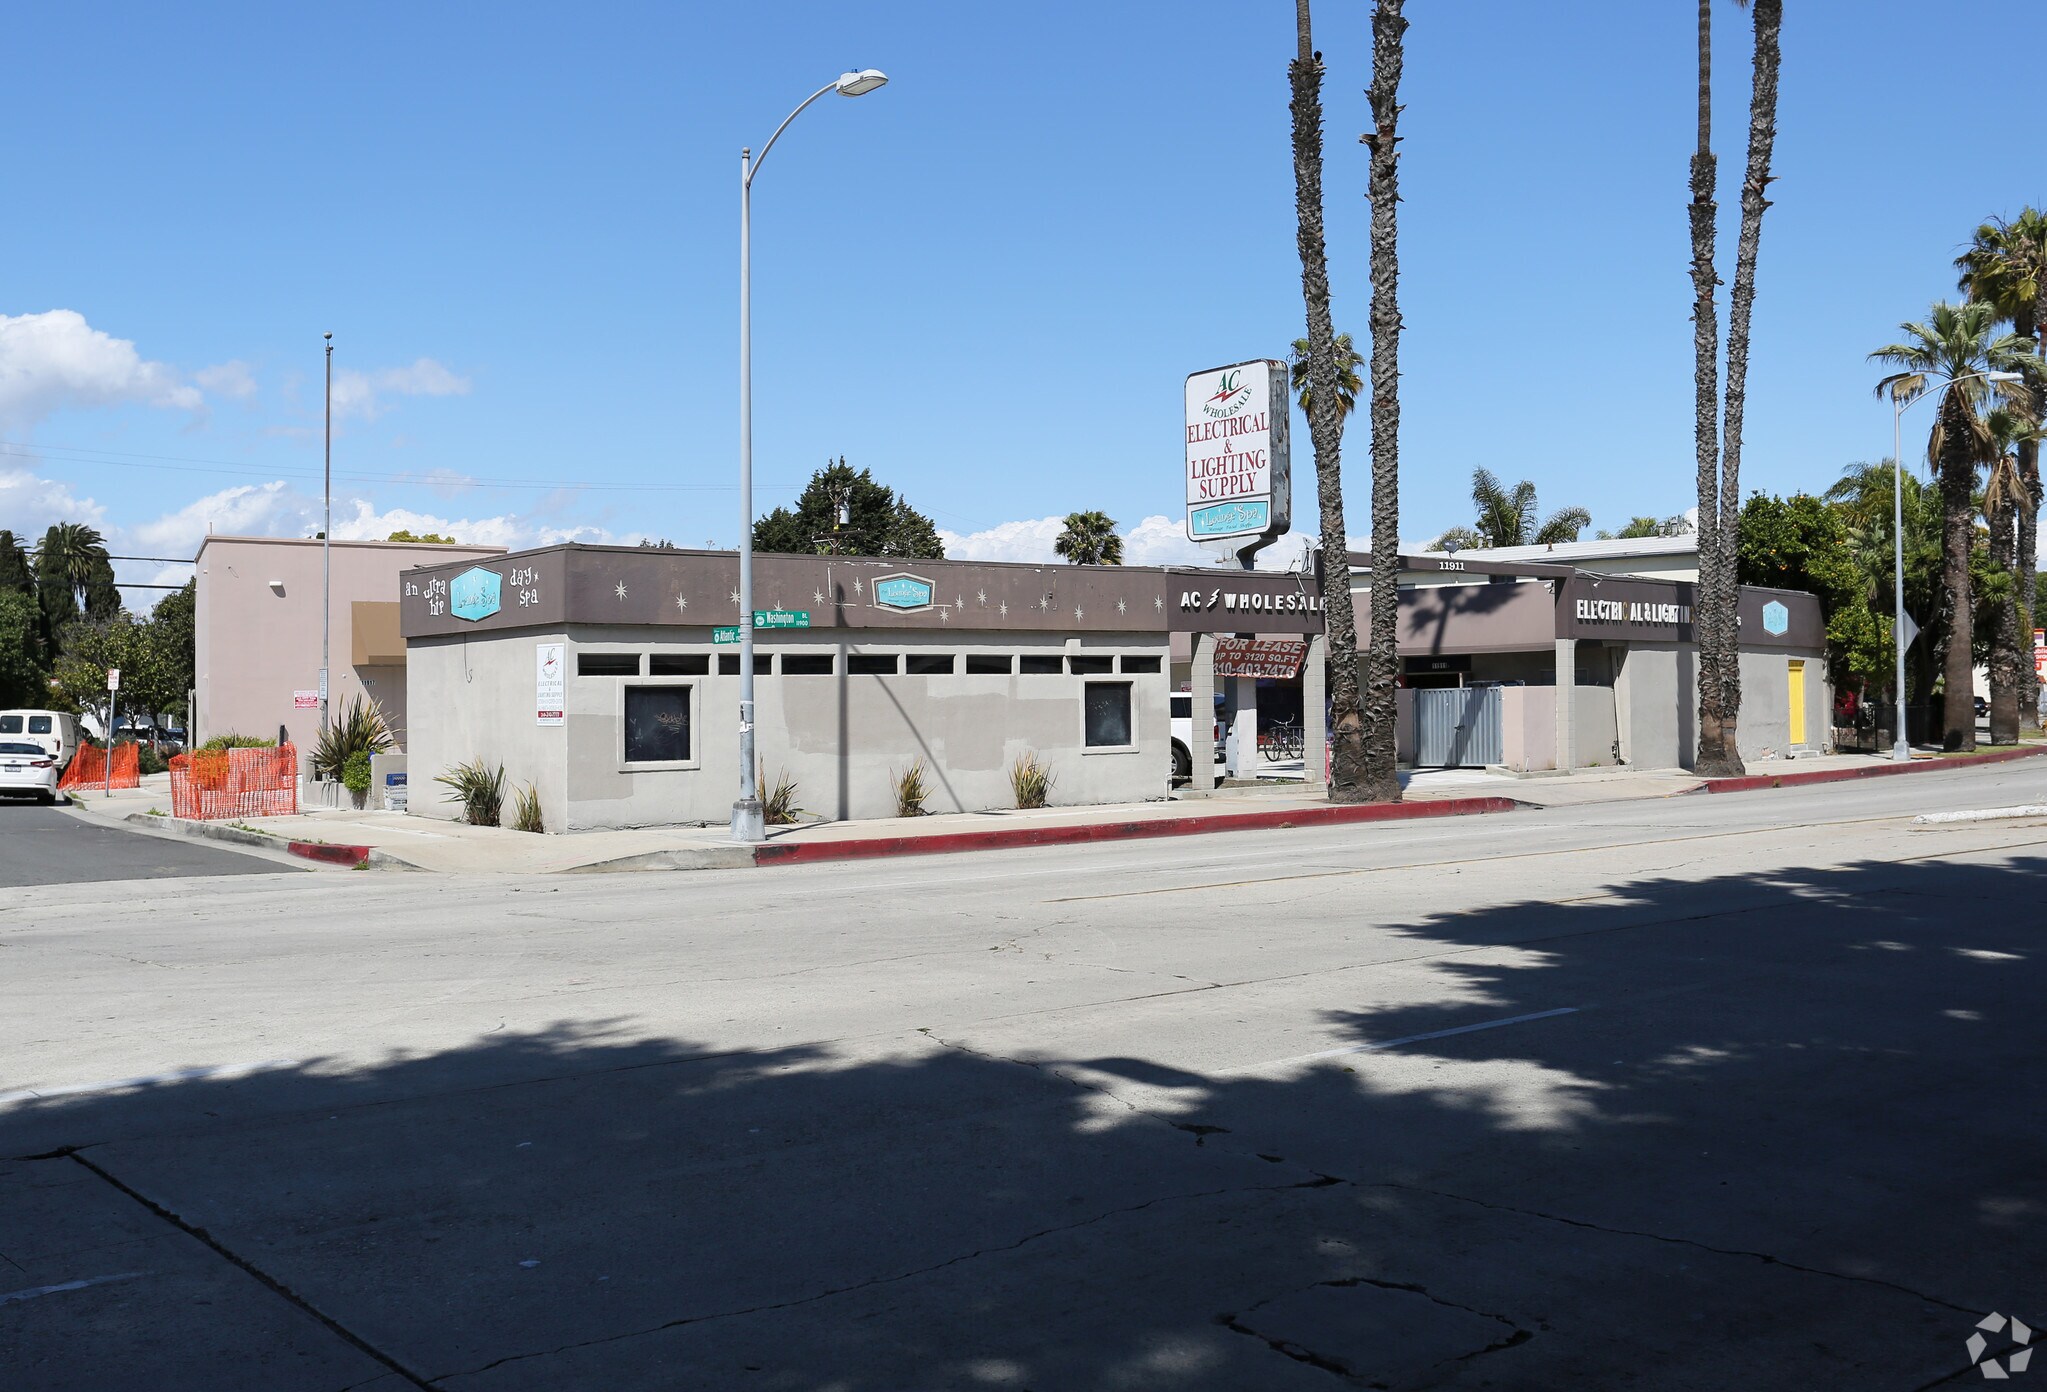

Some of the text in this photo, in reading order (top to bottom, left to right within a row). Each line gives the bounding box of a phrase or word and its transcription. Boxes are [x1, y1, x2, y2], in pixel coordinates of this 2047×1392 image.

[1215, 369, 1241, 395] AC
[1203, 388, 1252, 418] WHOLESALE
[1187, 412, 1269, 444] ELECTRICAL
[1224, 439, 1232, 454] &
[1191, 449, 1266, 479] LIGHTING
[1200, 472, 1257, 499] SUPPLY
[1439, 562, 1465, 570] 11911
[509, 566, 532, 587] day
[405, 576, 446, 599] an ultra
[429, 595, 444, 615] hip
[1180, 591, 1201, 607] AC
[766, 612, 795, 627] Washington
[720, 629, 735, 641] Atlantic
[1218, 638, 1302, 654] FOR LEASE
[1215, 652, 1226, 660] UP
[1229, 652, 1242, 660] TO
[1244, 653, 1265, 661] 3120
